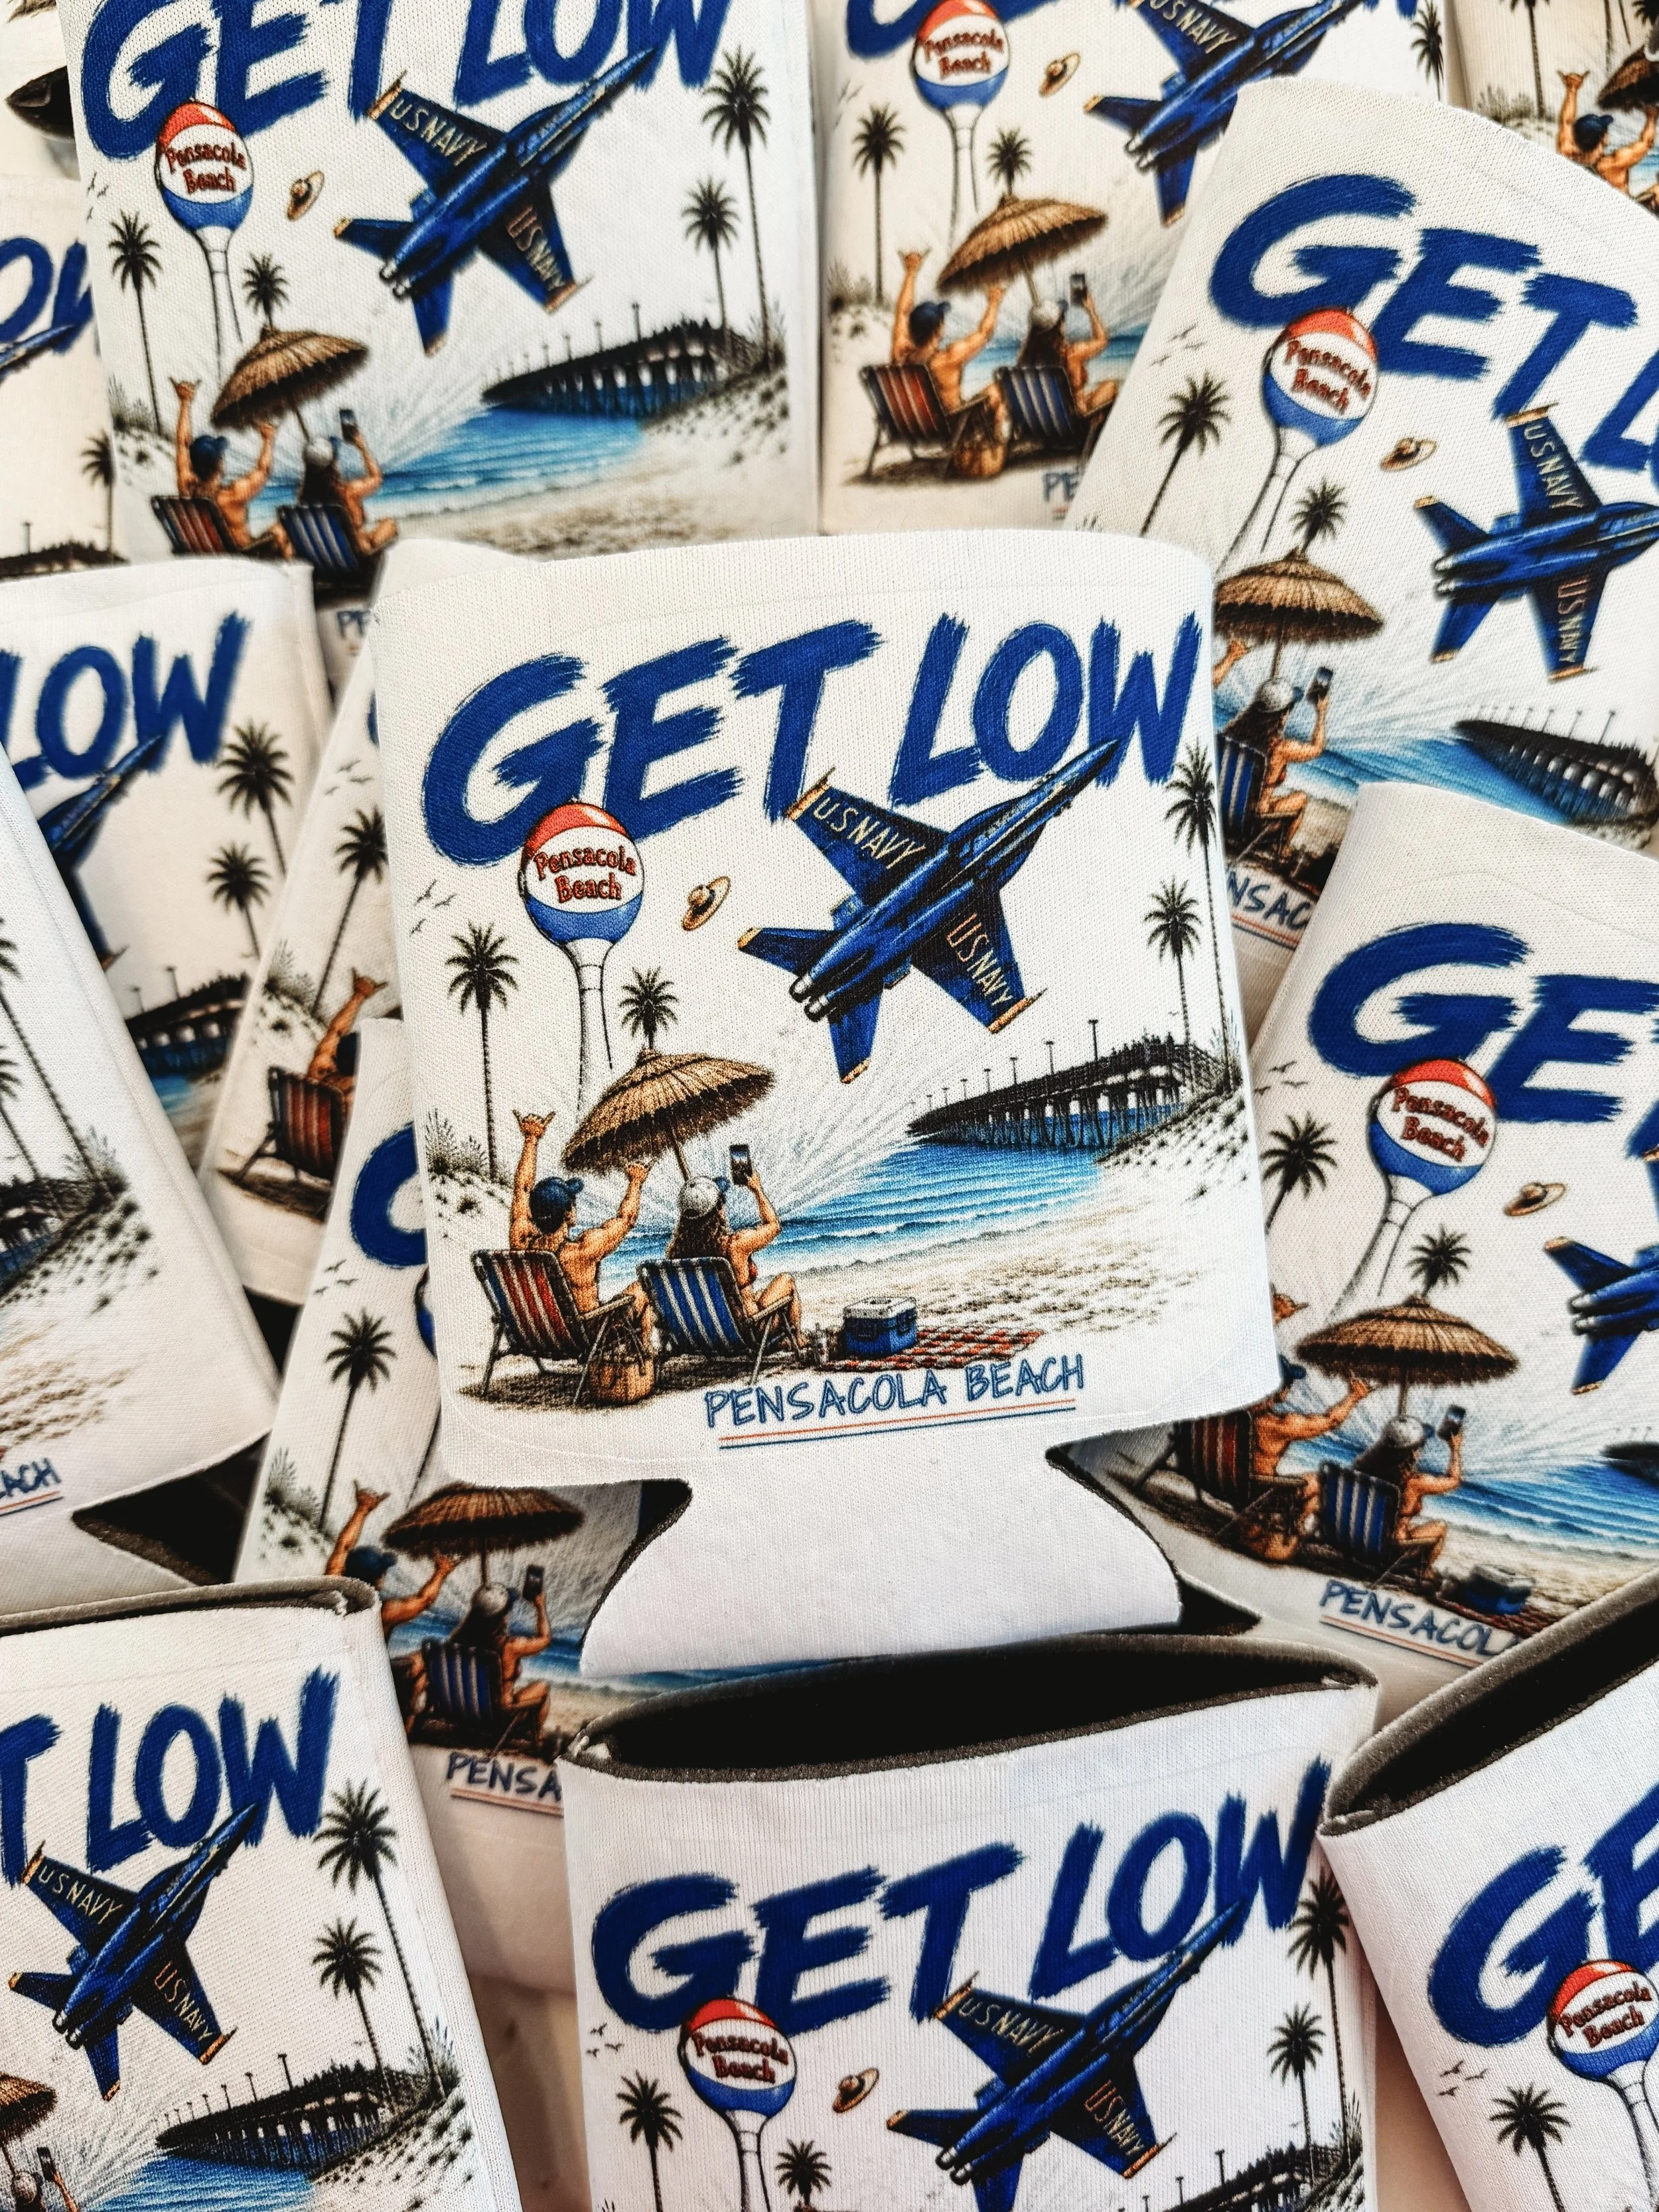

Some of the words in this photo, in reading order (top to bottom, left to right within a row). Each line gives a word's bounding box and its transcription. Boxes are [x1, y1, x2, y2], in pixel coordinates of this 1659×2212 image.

[81, 0, 393, 161] GET
[455, 0, 731, 108] LOW
[182, 167, 236, 194] Beach
[1209, 173, 1639, 419] GET
[421, 618, 888, 870] GET
[888, 611, 1202, 815] LOW
[532, 845, 637, 880] Pensacola
[553, 872, 622, 904] Beach
[1392, 1086, 1489, 1148] Pensacola
[1401, 1116, 1465, 1162] Beach
[703, 1367, 948, 1428] PENSACOLA
[964, 1353, 1084, 1402] BEACH
[0, 1457, 62, 1499] ACH
[86, 1664, 341, 1875] LOW
[591, 1840, 1027, 2038] GET
[1029, 1756, 1331, 2000] LOW
[1558, 1980, 1652, 2038] Pensacola
[1583, 2004, 1645, 2048] Beach
[711, 2053, 776, 2085] Beach
